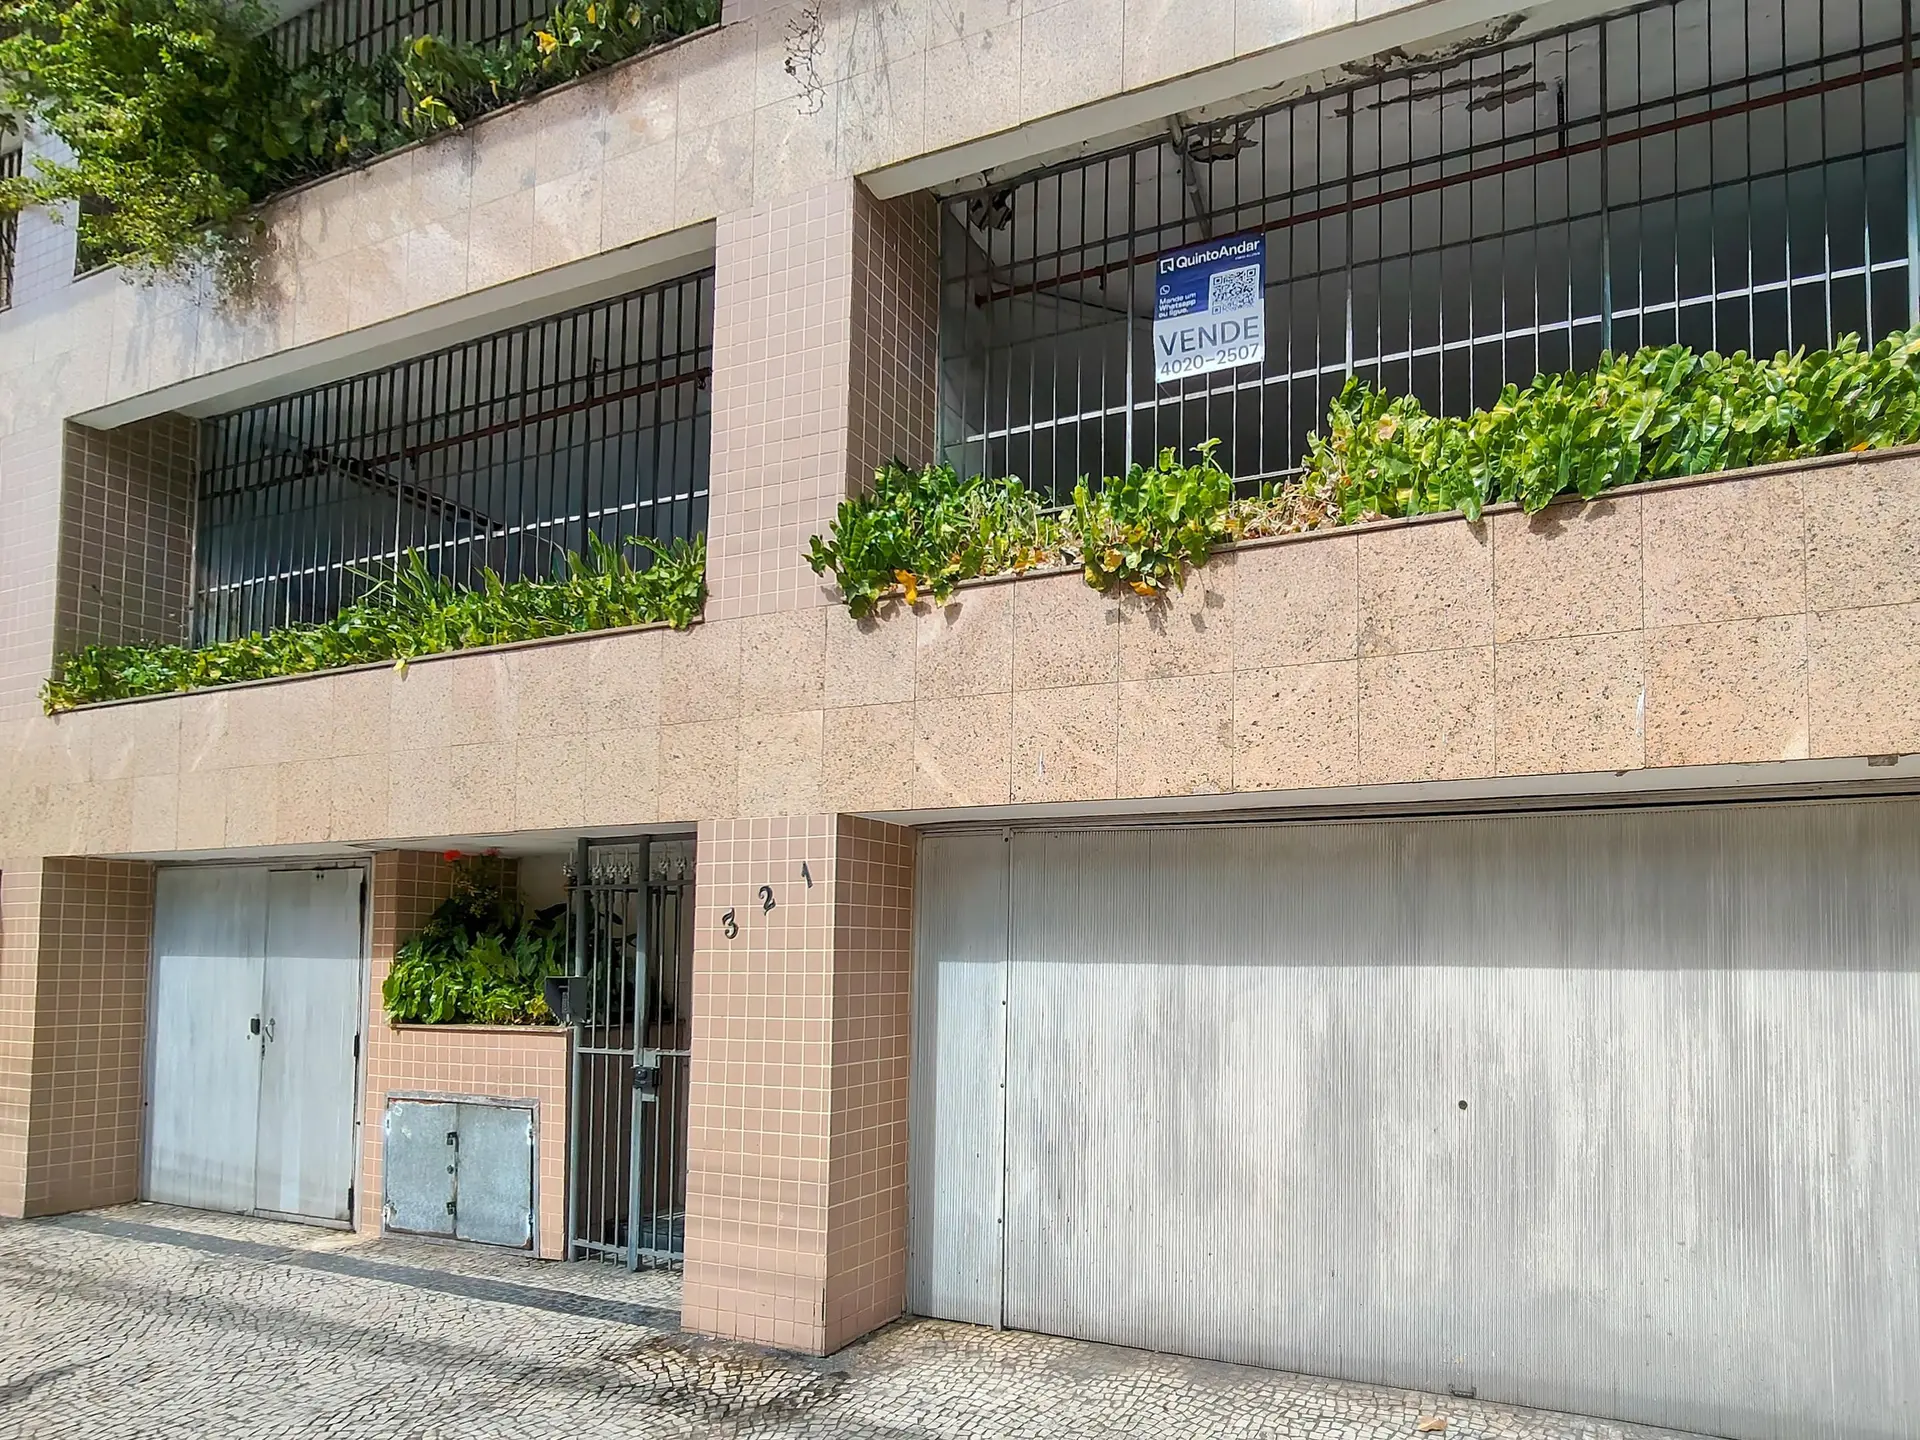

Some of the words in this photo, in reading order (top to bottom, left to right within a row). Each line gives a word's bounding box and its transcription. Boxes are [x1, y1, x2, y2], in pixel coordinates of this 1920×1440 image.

[1176, 240, 1261, 269] QuintoAndar
[1185, 292, 1197, 300] um
[1159, 315, 1260, 356] VENDE
[1160, 342, 1260, 376] 4020-2507
